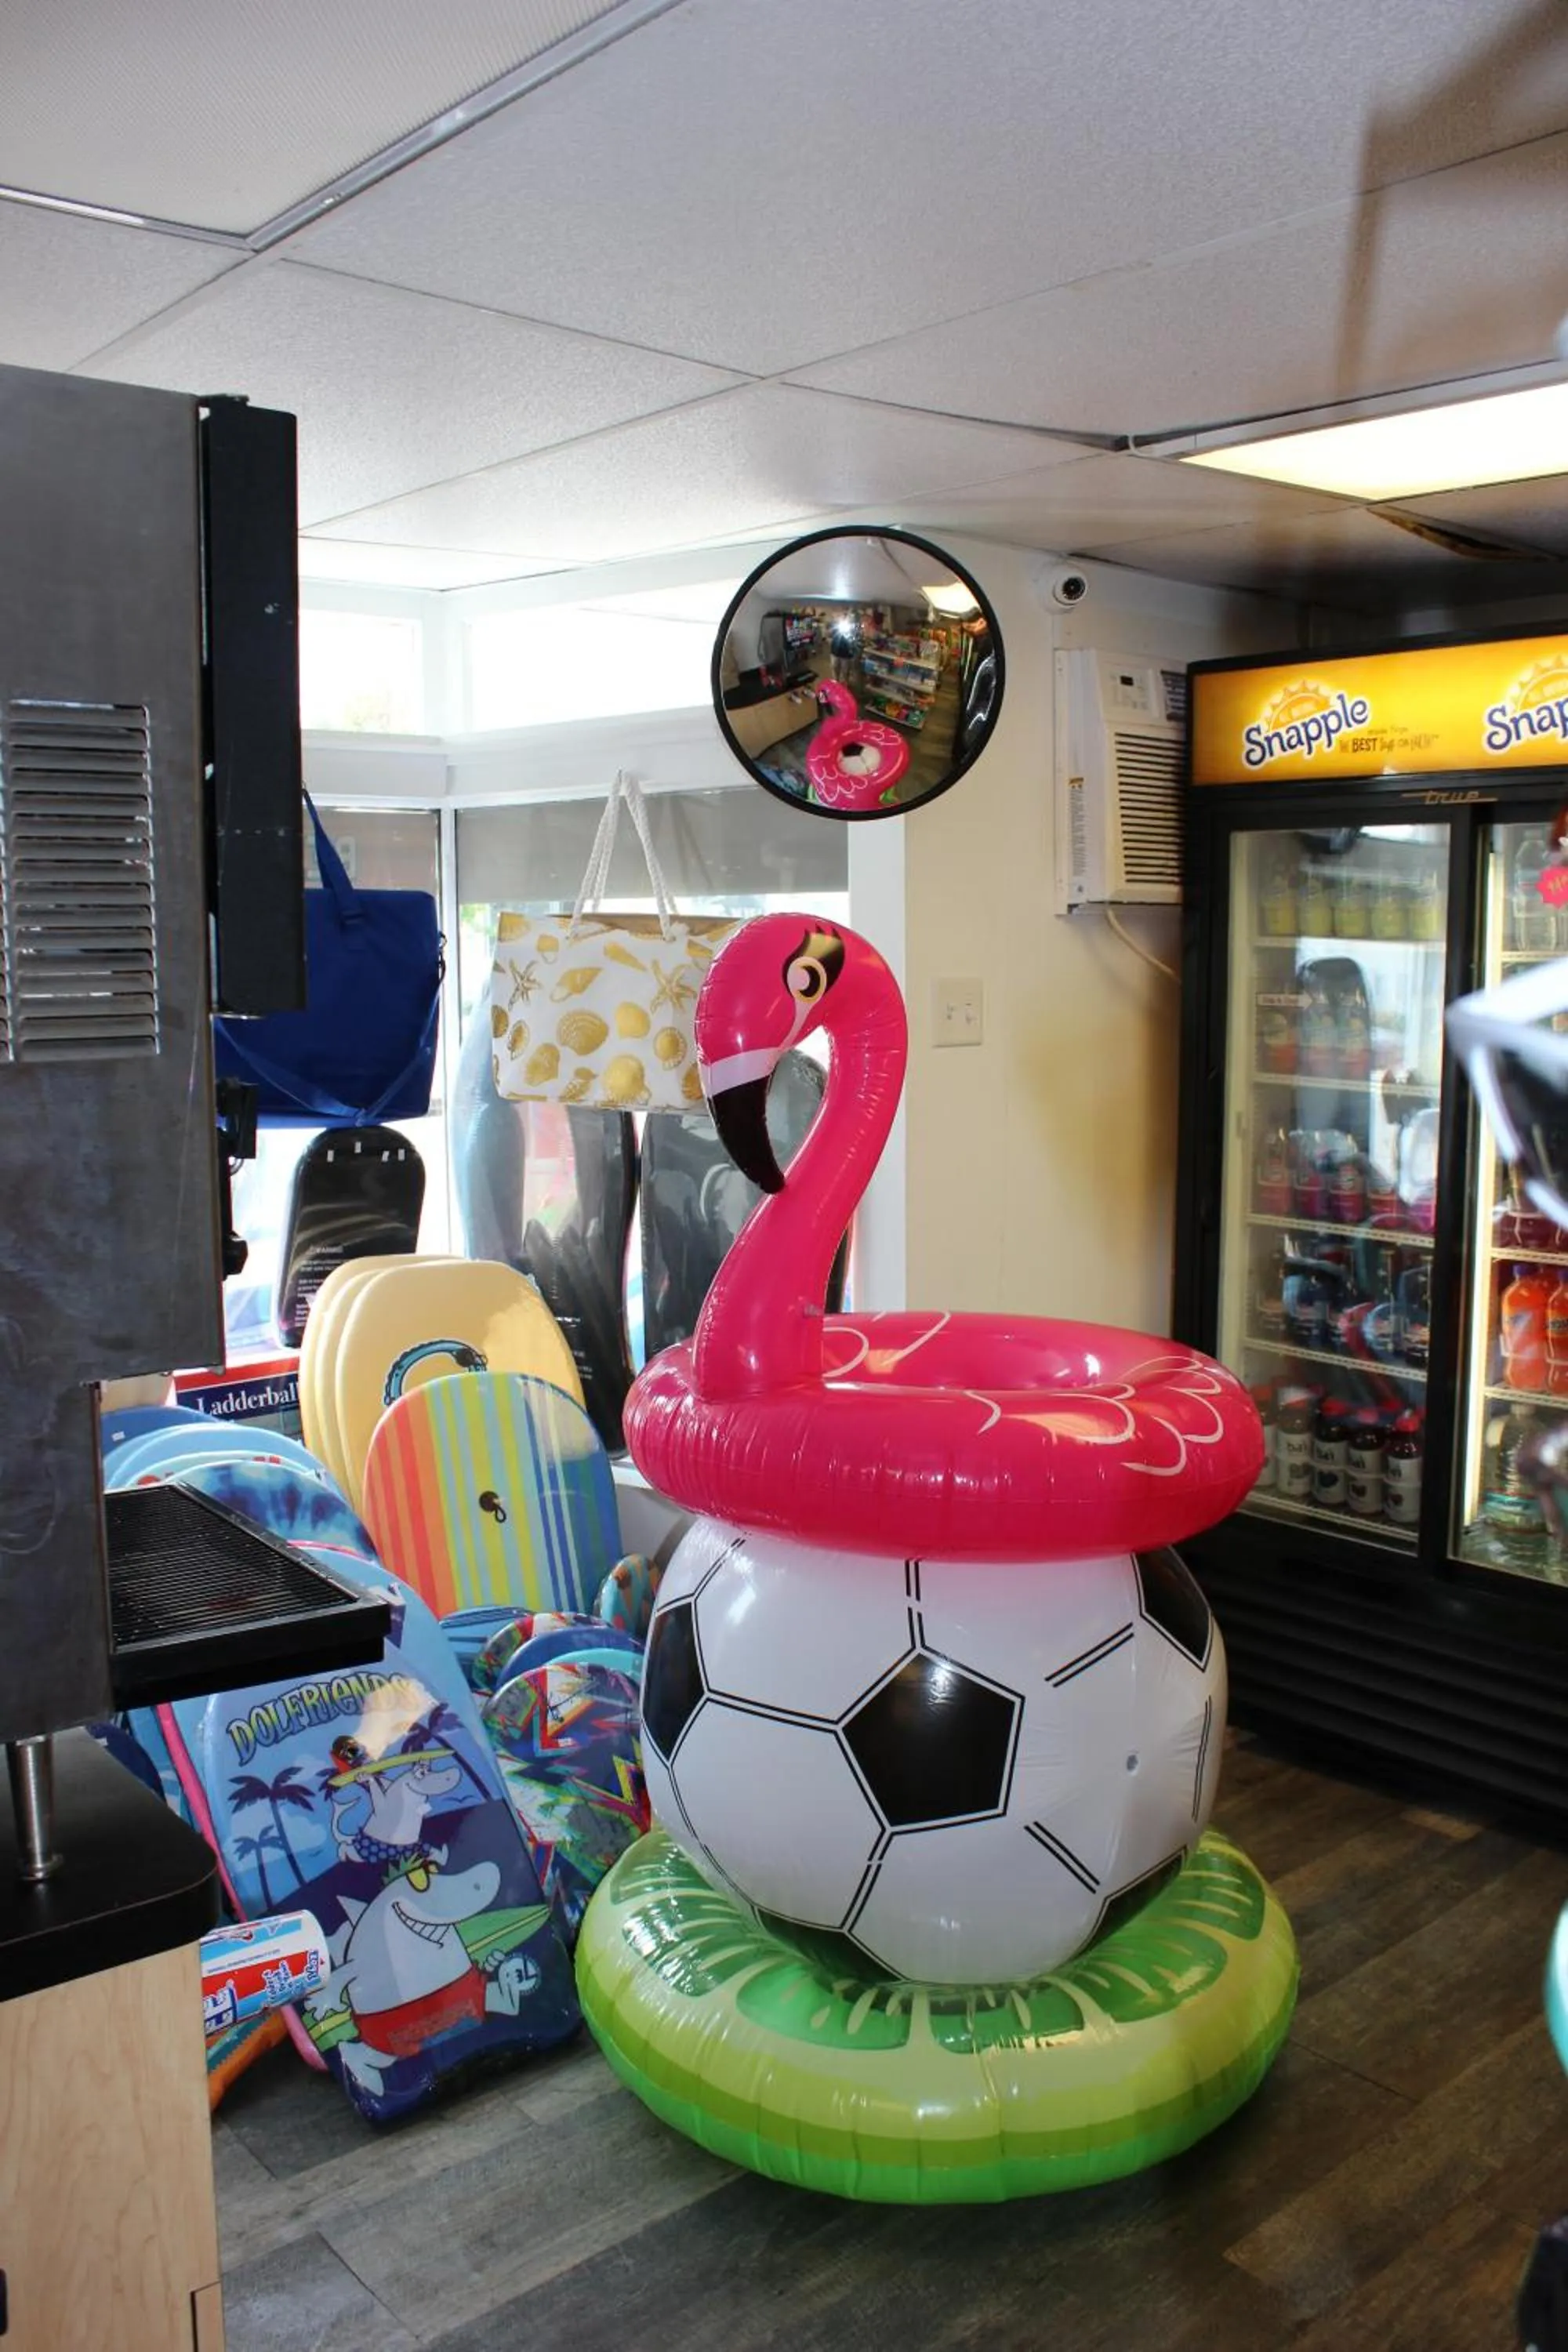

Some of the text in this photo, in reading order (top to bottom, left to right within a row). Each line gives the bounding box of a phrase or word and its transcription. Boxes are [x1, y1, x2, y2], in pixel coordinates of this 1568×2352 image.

[1245, 694, 1368, 765] Snapple
[1352, 738, 1377, 753] BEST
[197, 1381, 299, 1416] Ladderbal
